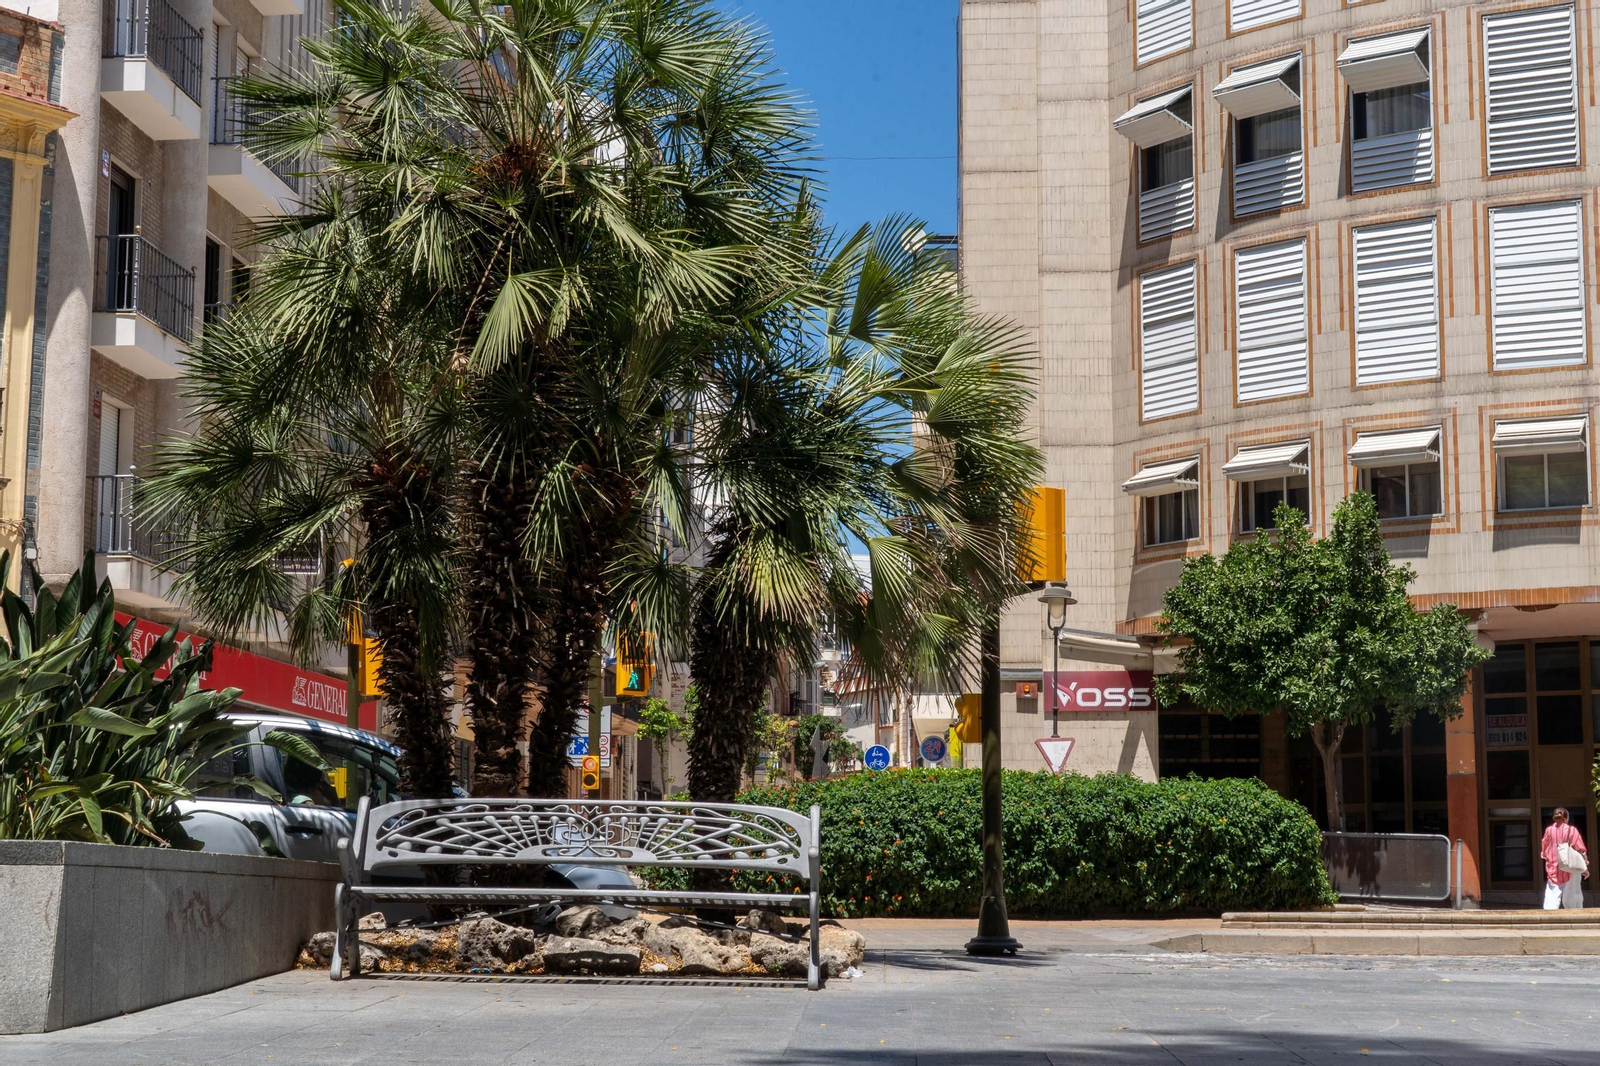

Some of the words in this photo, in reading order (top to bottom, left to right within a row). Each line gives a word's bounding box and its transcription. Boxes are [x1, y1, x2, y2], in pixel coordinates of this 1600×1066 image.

[307, 680, 347, 717] GENERAL
[1488, 717, 1497, 727] SE
[1498, 716, 1526, 726] ALQUILA
